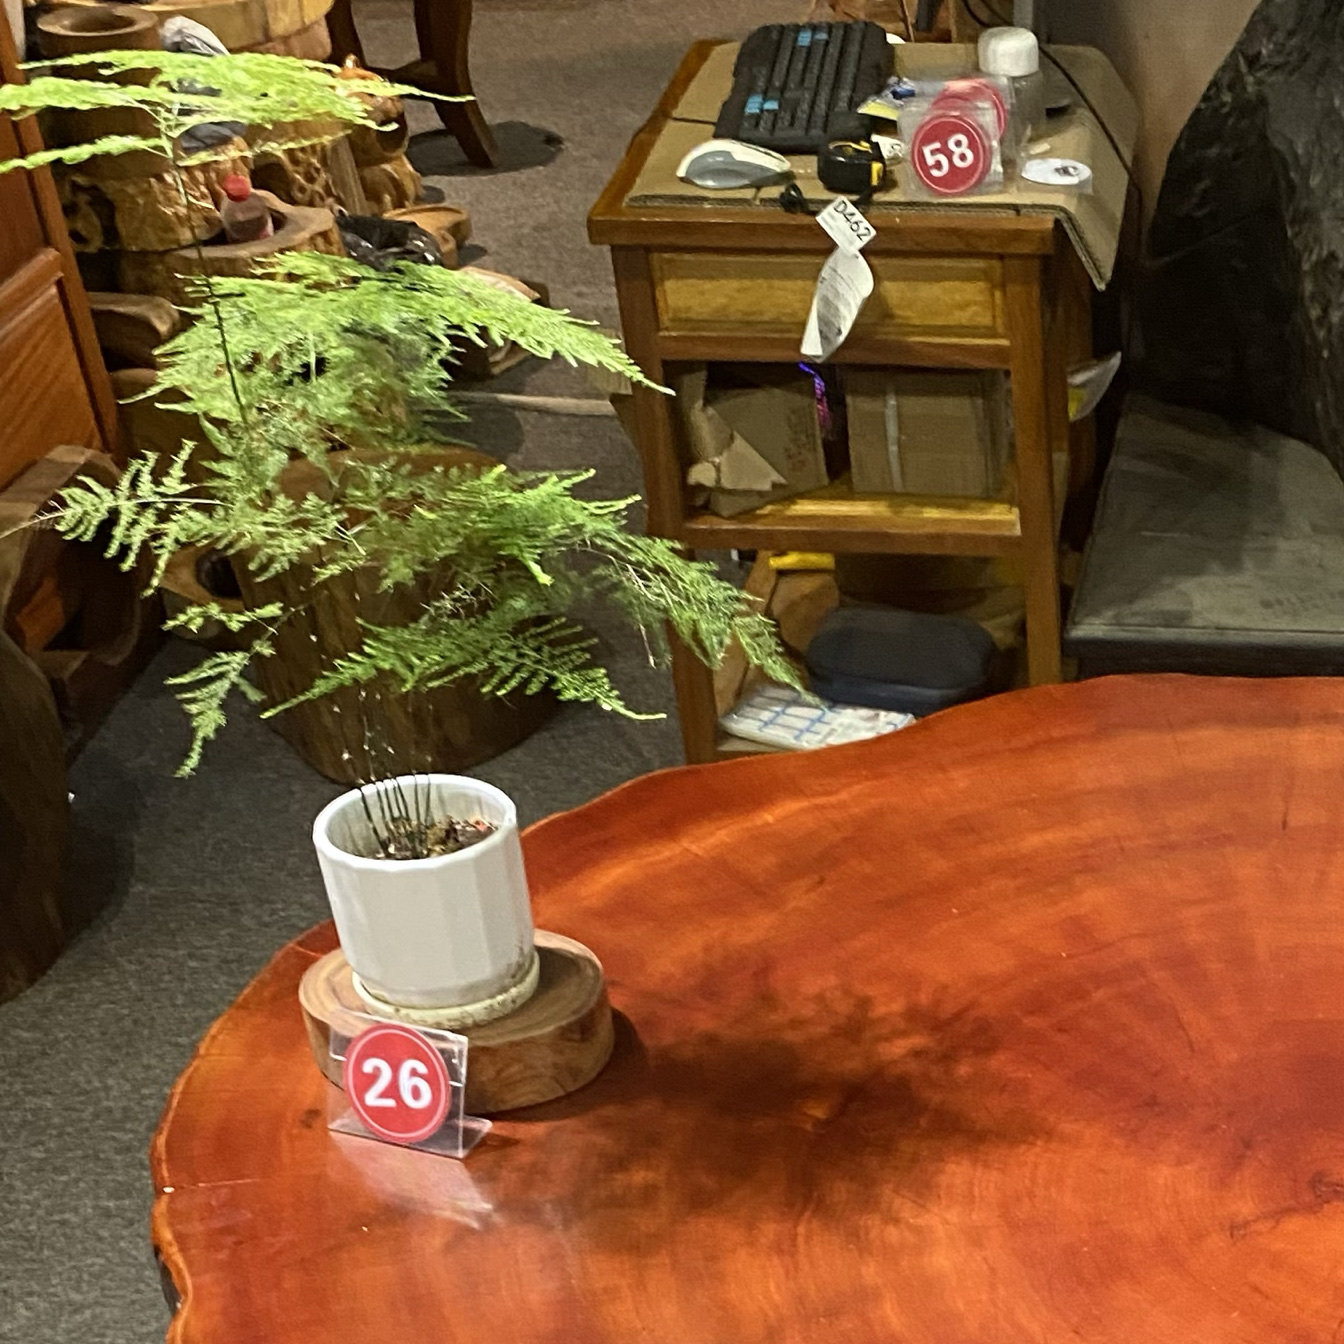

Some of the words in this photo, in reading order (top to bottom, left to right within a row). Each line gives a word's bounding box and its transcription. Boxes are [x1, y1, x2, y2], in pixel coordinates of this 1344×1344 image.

[922, 133, 974, 177] 58
[833, 200, 871, 241] D462
[362, 1057, 432, 1109] 26
